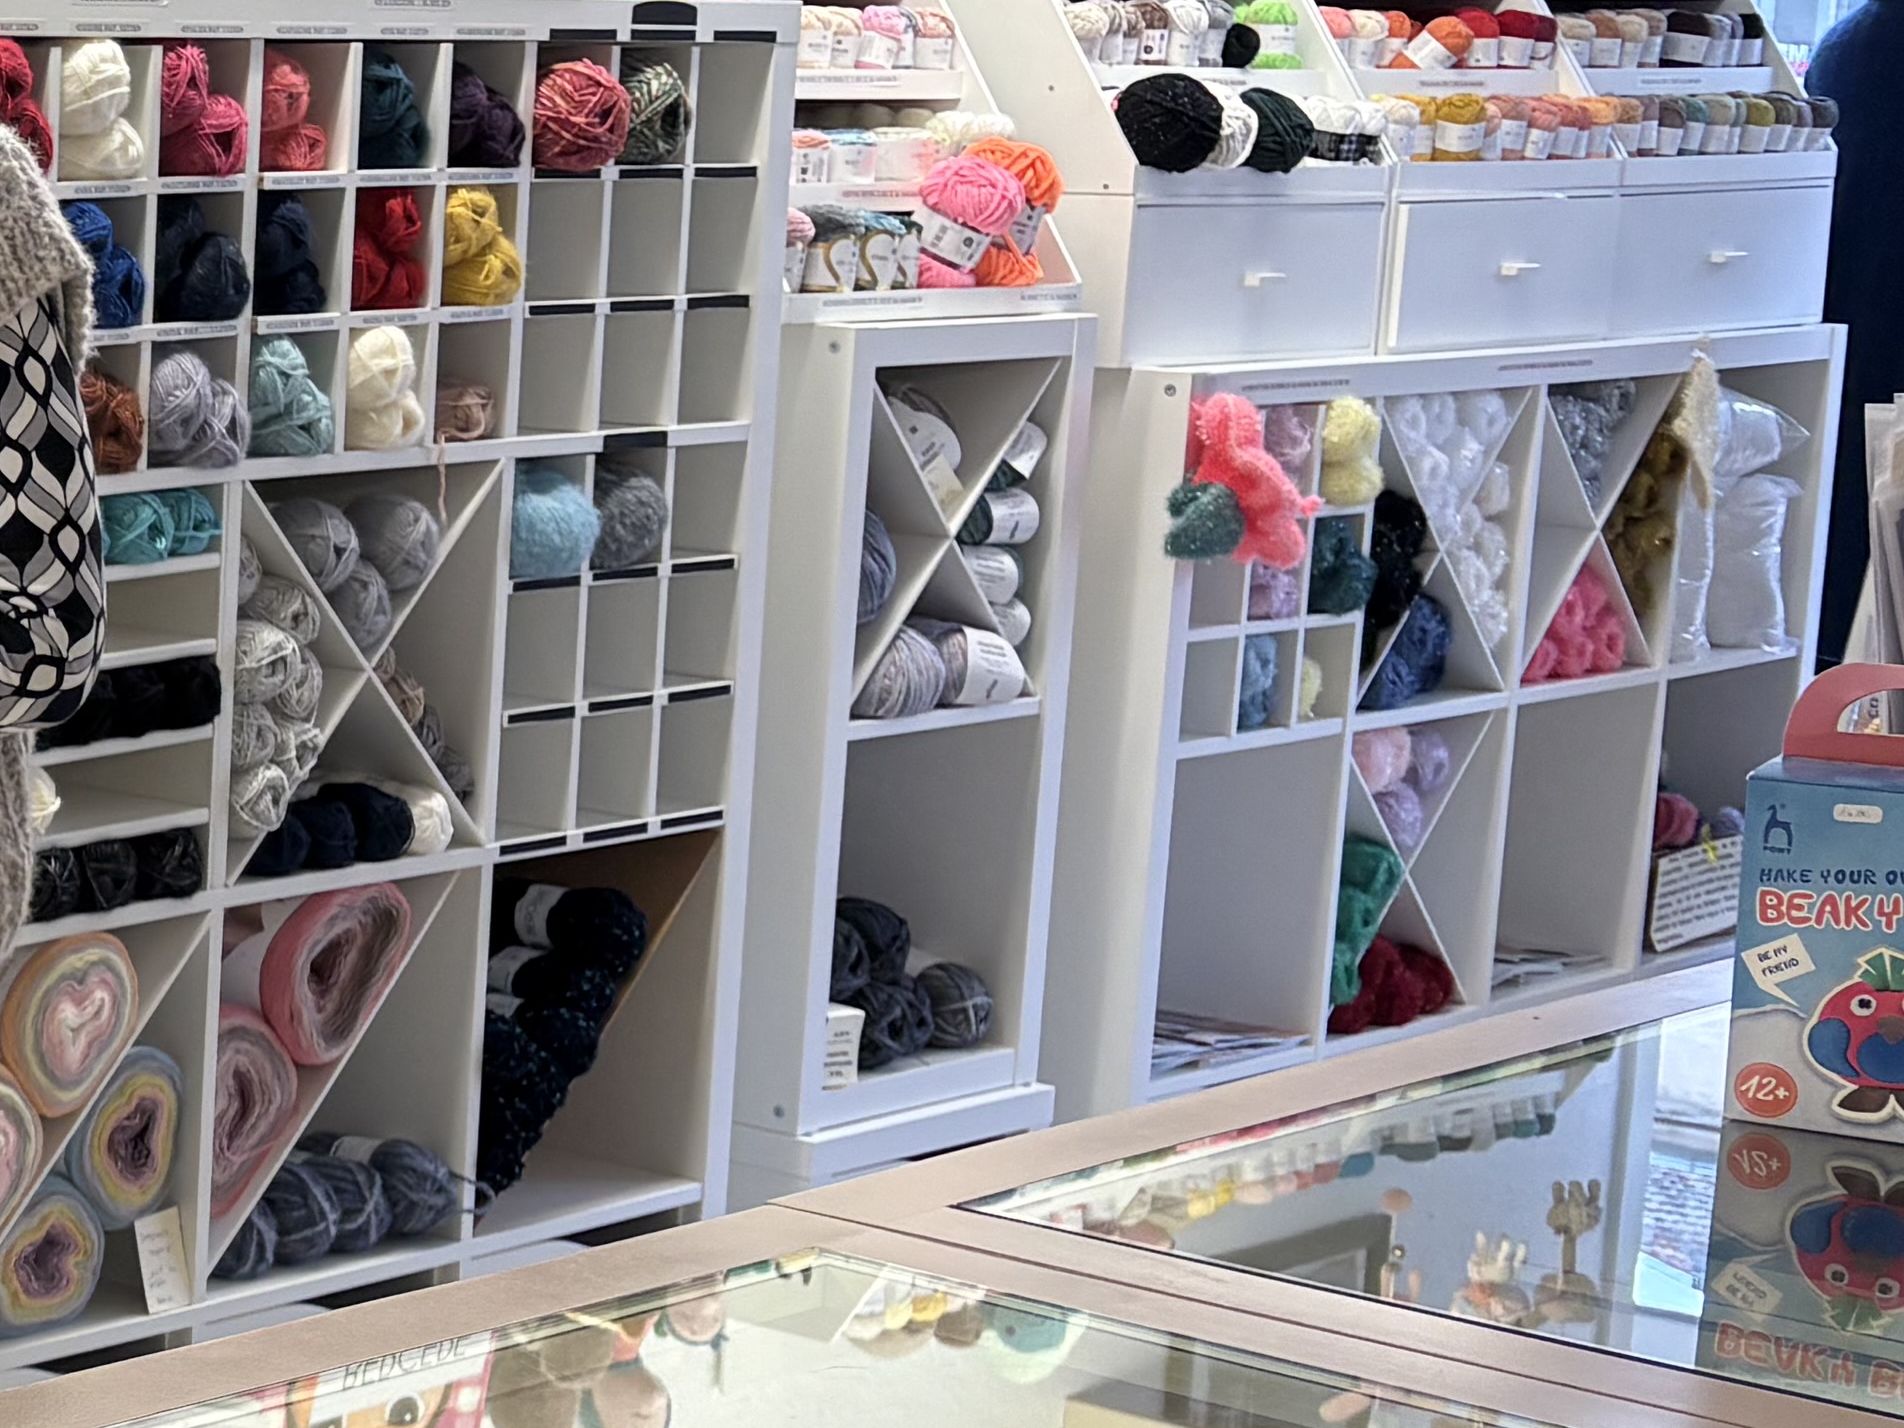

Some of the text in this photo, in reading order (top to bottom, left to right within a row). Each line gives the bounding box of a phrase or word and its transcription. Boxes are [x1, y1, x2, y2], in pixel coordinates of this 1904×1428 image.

[1820, 868, 1877, 885] YOUR
[1756, 887, 1904, 933] BEAKY
[1739, 1076, 1790, 1102] 12+
